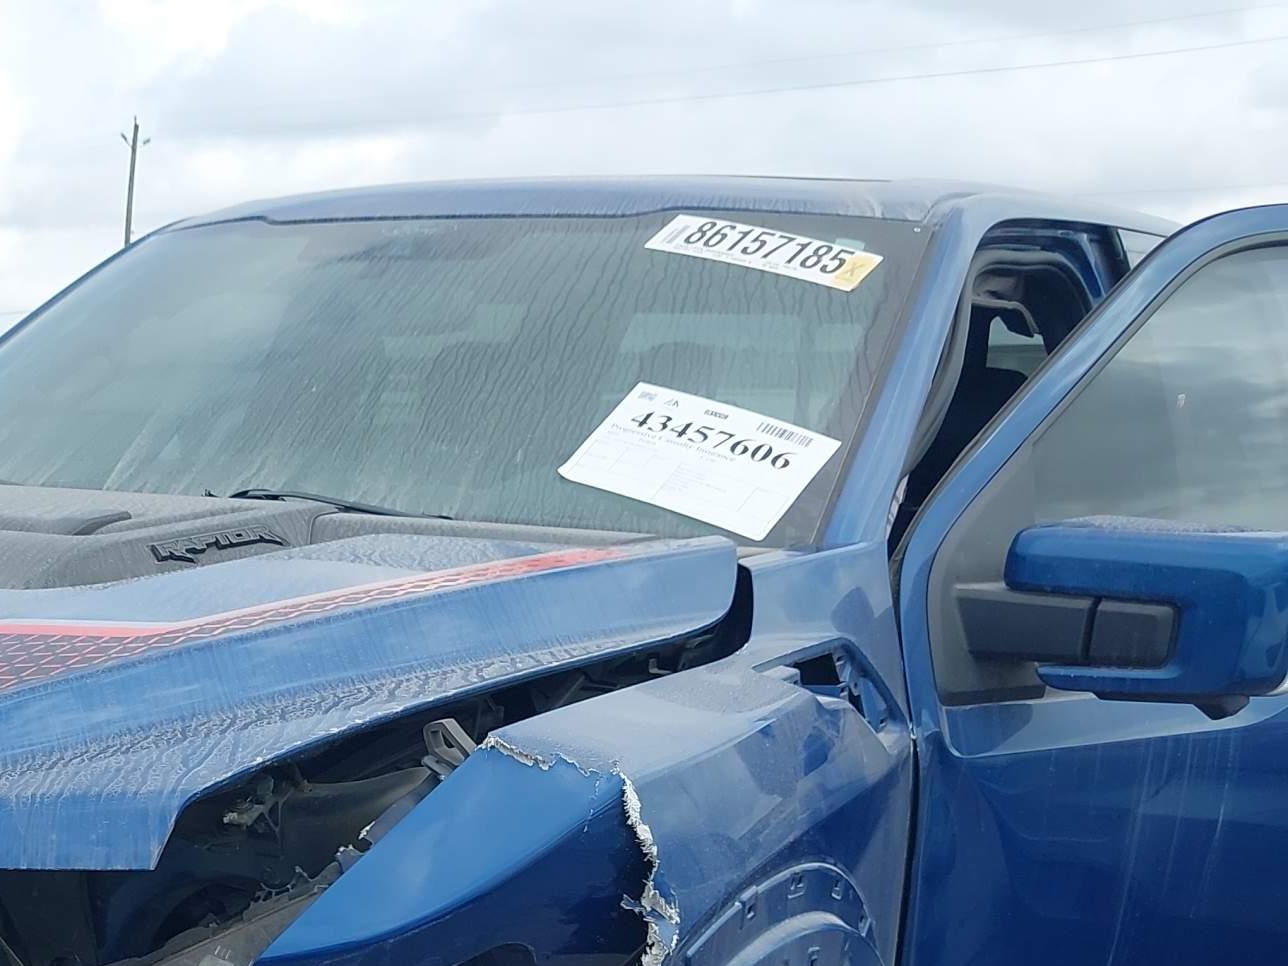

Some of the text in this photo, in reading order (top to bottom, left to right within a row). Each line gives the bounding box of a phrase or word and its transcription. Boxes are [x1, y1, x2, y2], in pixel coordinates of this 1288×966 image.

[684, 221, 855, 275] 86157185
[631, 410, 798, 471] 43457606
[150, 526, 290, 563] RAPTOR
